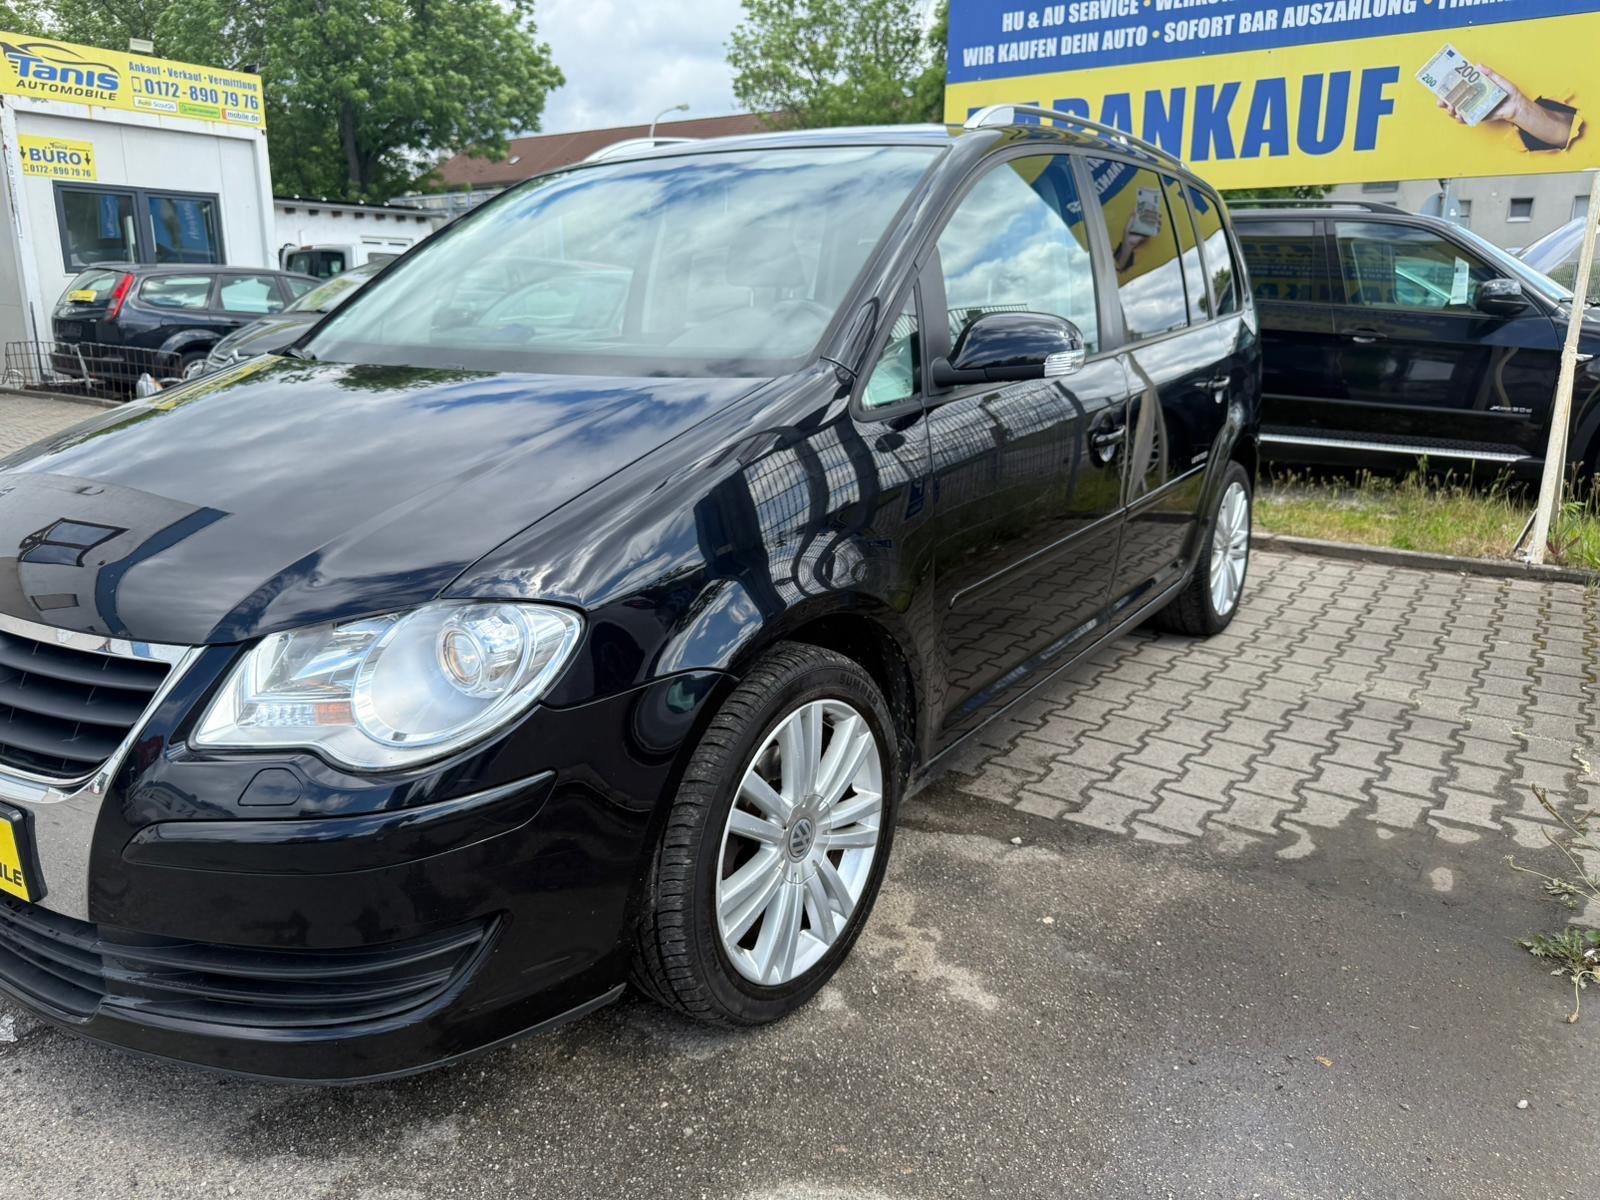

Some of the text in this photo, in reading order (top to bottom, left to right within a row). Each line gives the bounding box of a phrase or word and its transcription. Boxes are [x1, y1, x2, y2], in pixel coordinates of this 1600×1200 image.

[1002, 11, 1025, 33] HU
[1027, 12, 1040, 29] &
[1042, 5, 1066, 28] AU
[1068, 0, 1139, 24] SERVICE
[963, 0, 1417, 67] WIR KAUFEN DEIN AUTO SOFORT BAR AUSZAHLUNG
[7, 53, 119, 91] Tanis
[129, 61, 258, 92] Ankauf Verkauf Vermittlung
[1421, 73, 1437, 88] 200
[1454, 60, 1481, 84] 200
[16, 79, 118, 101] AUTOMOBILE
[144, 78, 180, 99] 0172
[189, 85, 219, 105] 890
[222, 90, 239, 107] 79
[242, 94, 259, 110] 76
[29, 145, 82, 165] BÜRO
[30, 164, 49, 174] 0172
